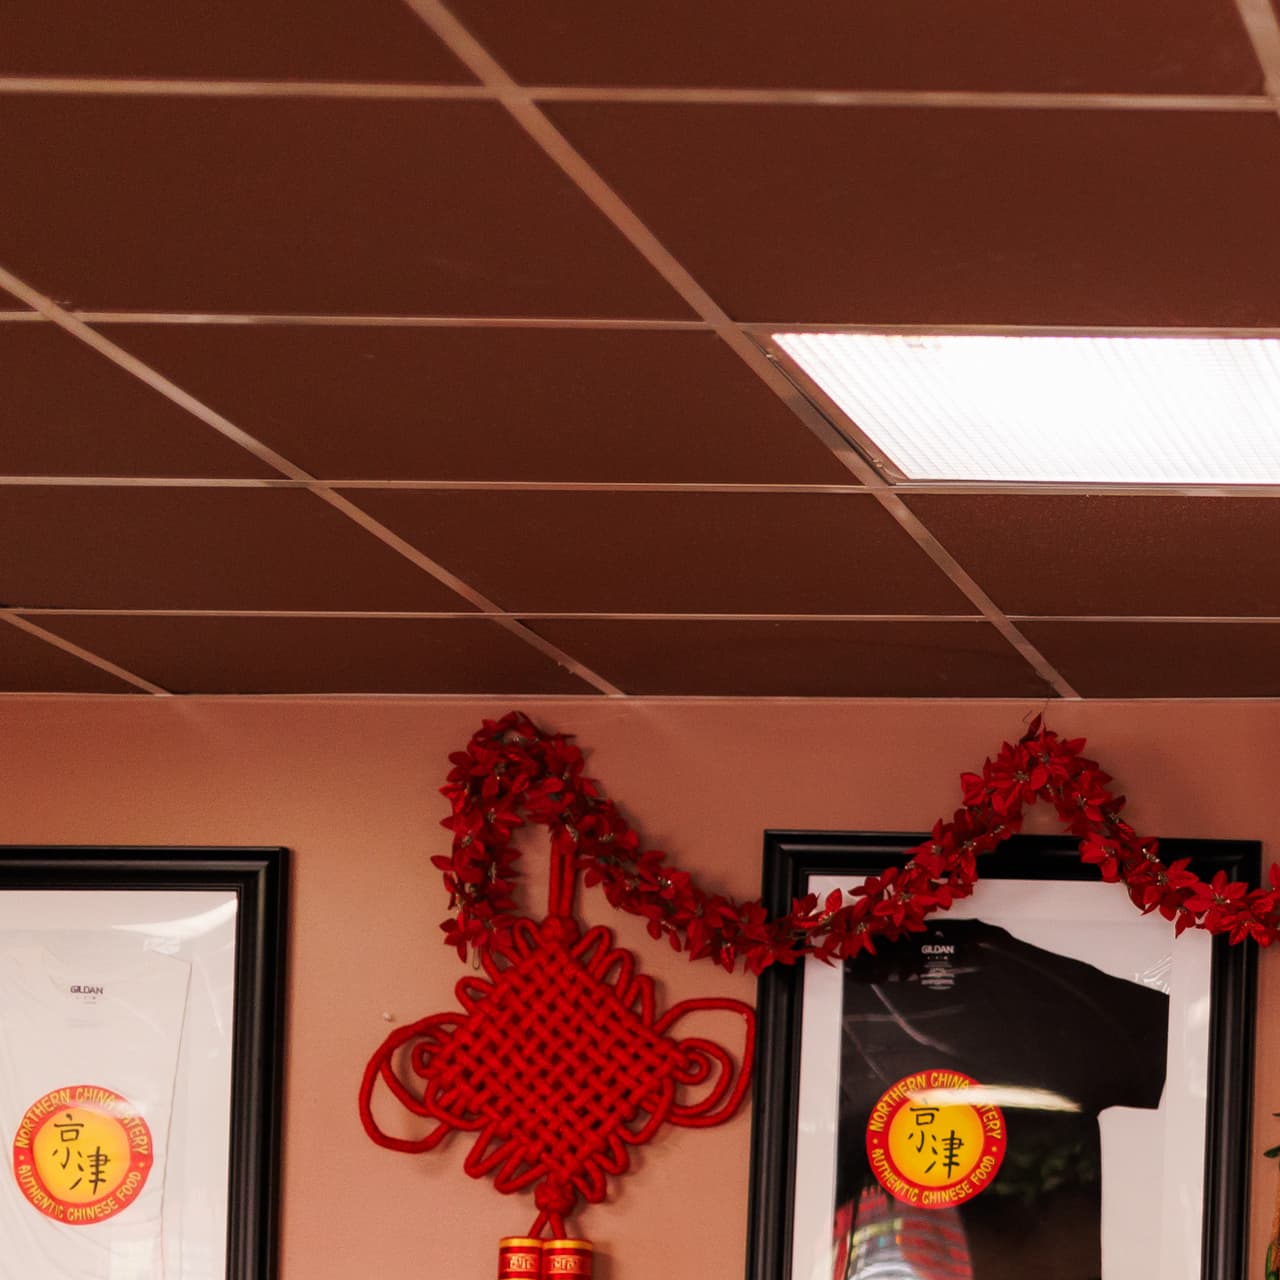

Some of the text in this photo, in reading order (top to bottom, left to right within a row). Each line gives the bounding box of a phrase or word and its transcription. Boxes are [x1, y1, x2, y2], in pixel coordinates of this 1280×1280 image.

[15, 1088, 71, 1148] NORTHERN
[869, 1074, 926, 1132] NORTHERN
[18, 1164, 142, 1221] AUTHENTIC CHINESE FOOD
[872, 1148, 996, 1204] AUTHENTIC CHINESE FOOD
